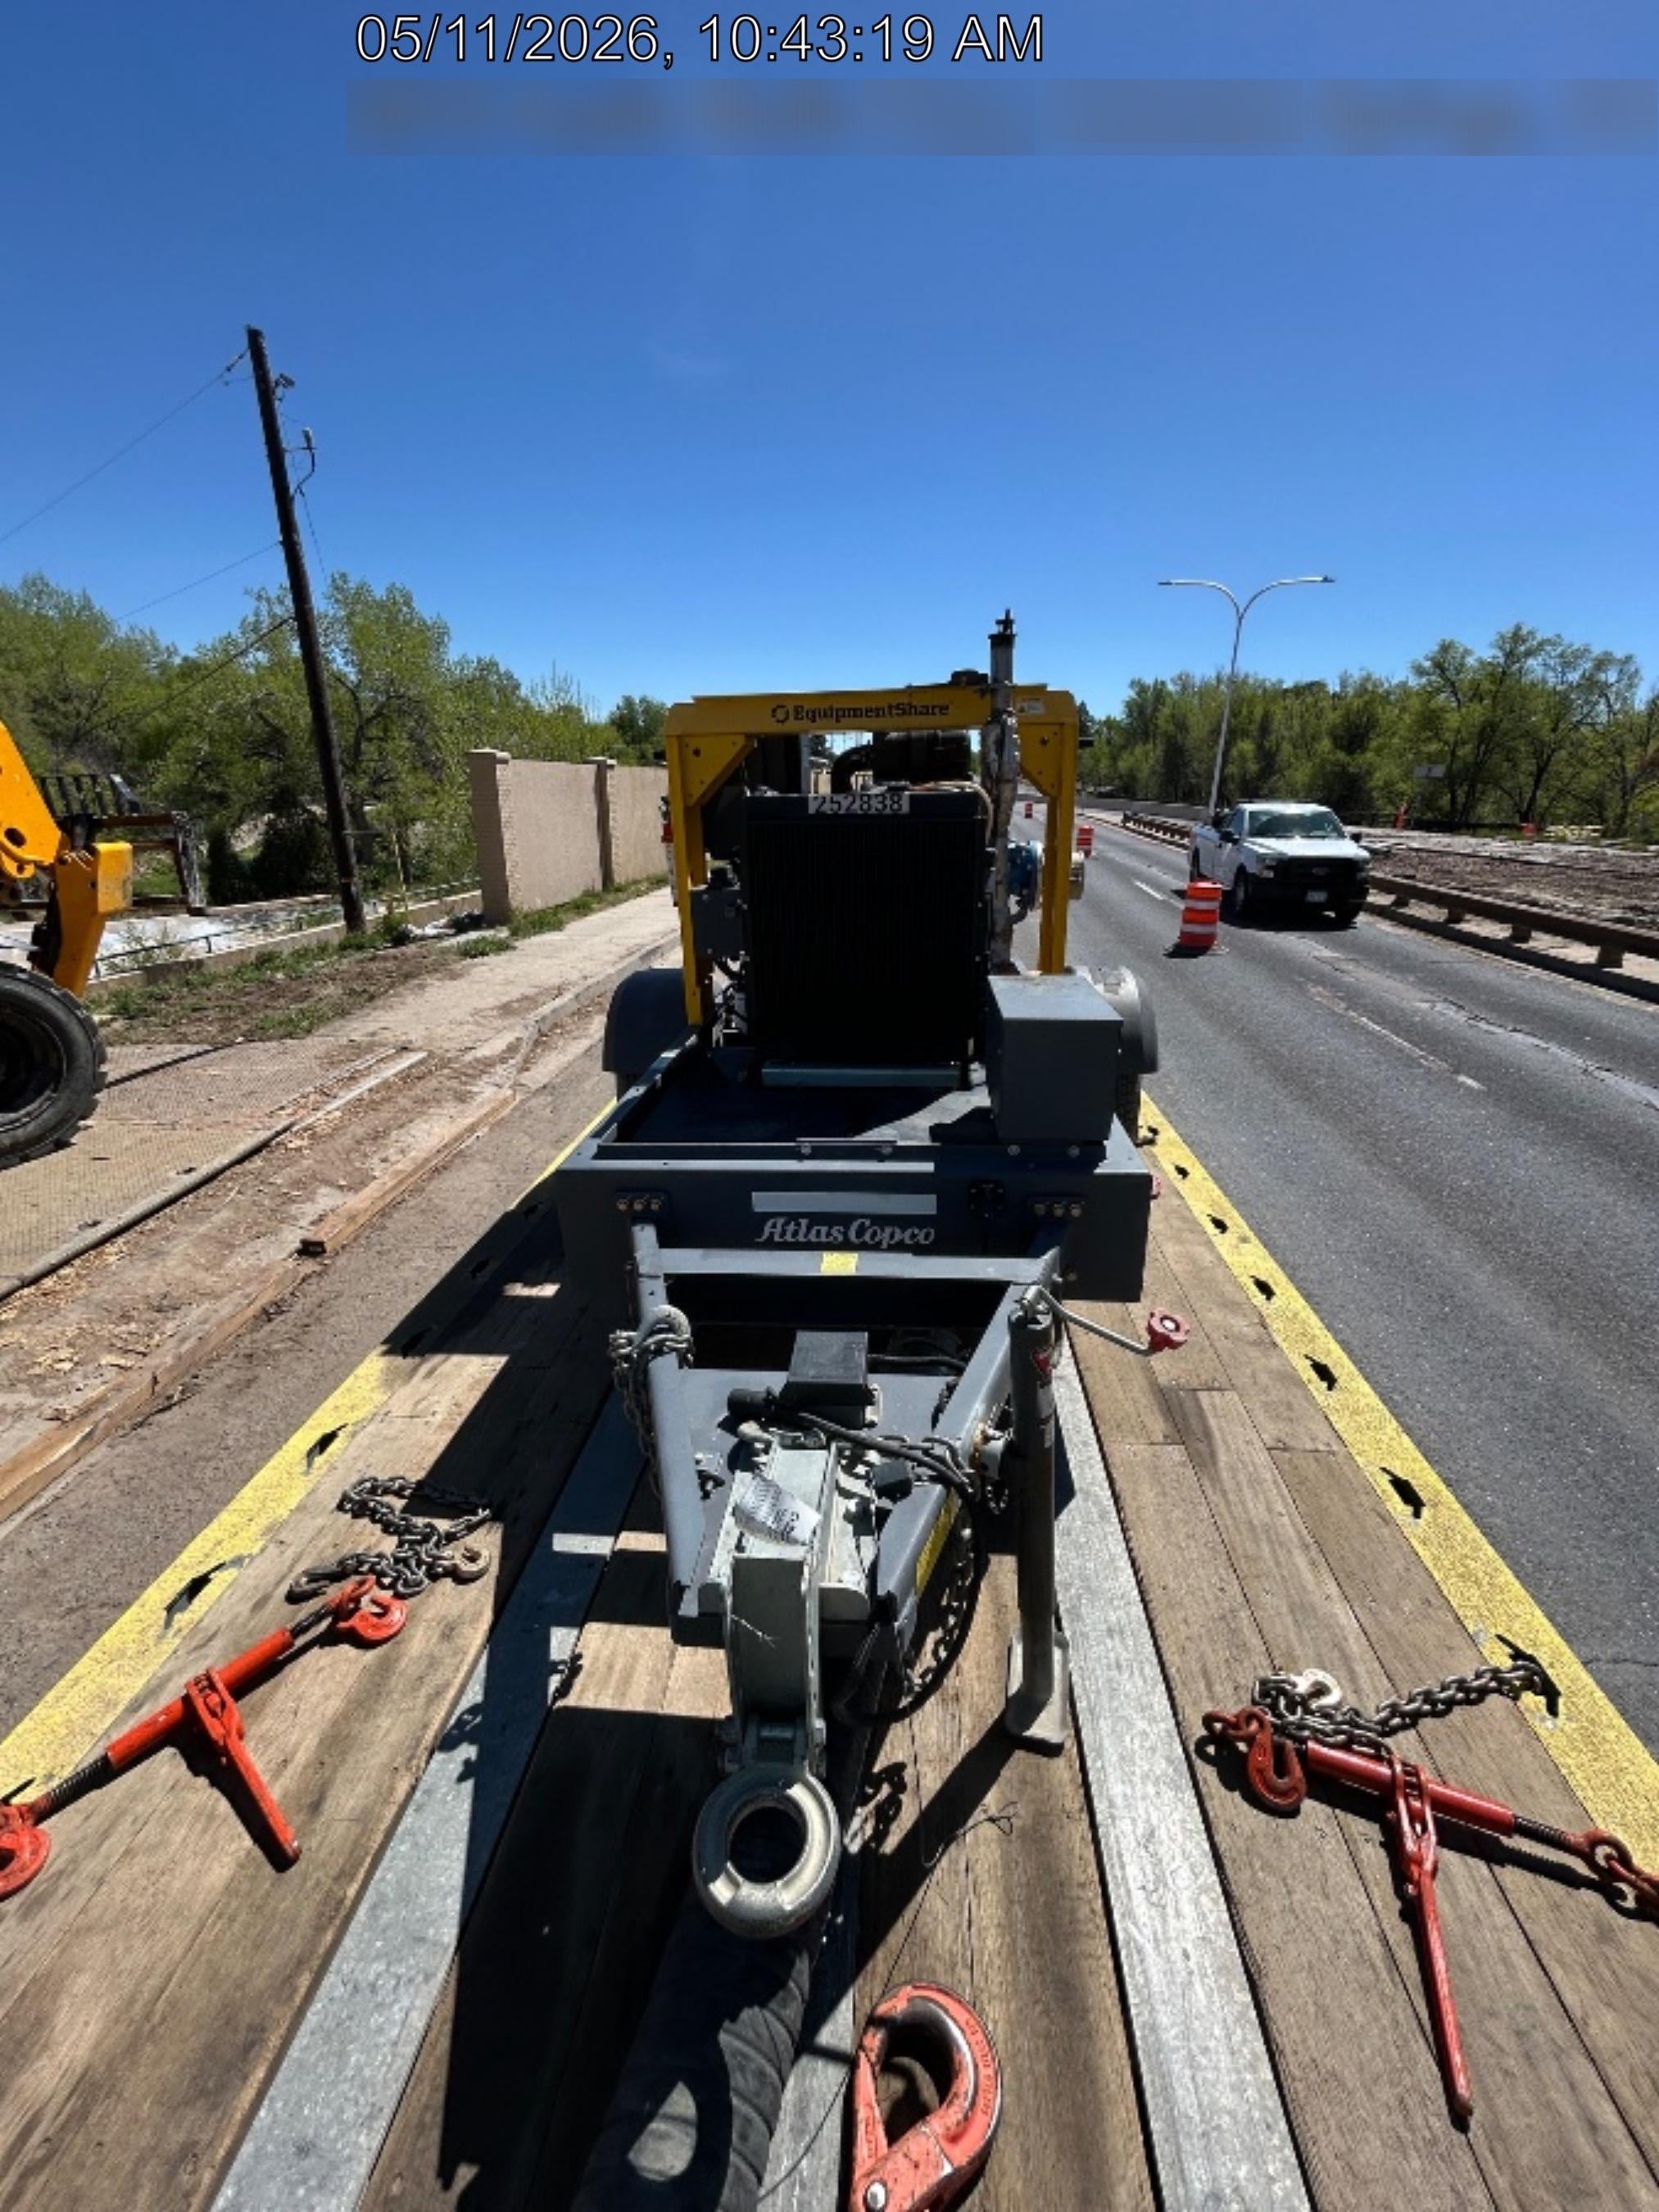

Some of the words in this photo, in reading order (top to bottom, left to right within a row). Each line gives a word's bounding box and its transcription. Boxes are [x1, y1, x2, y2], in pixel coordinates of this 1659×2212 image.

[793, 702, 950, 723] EquipmentShare
[755, 1217, 845, 1243] Atlas
[847, 1218, 936, 1249] Copco
